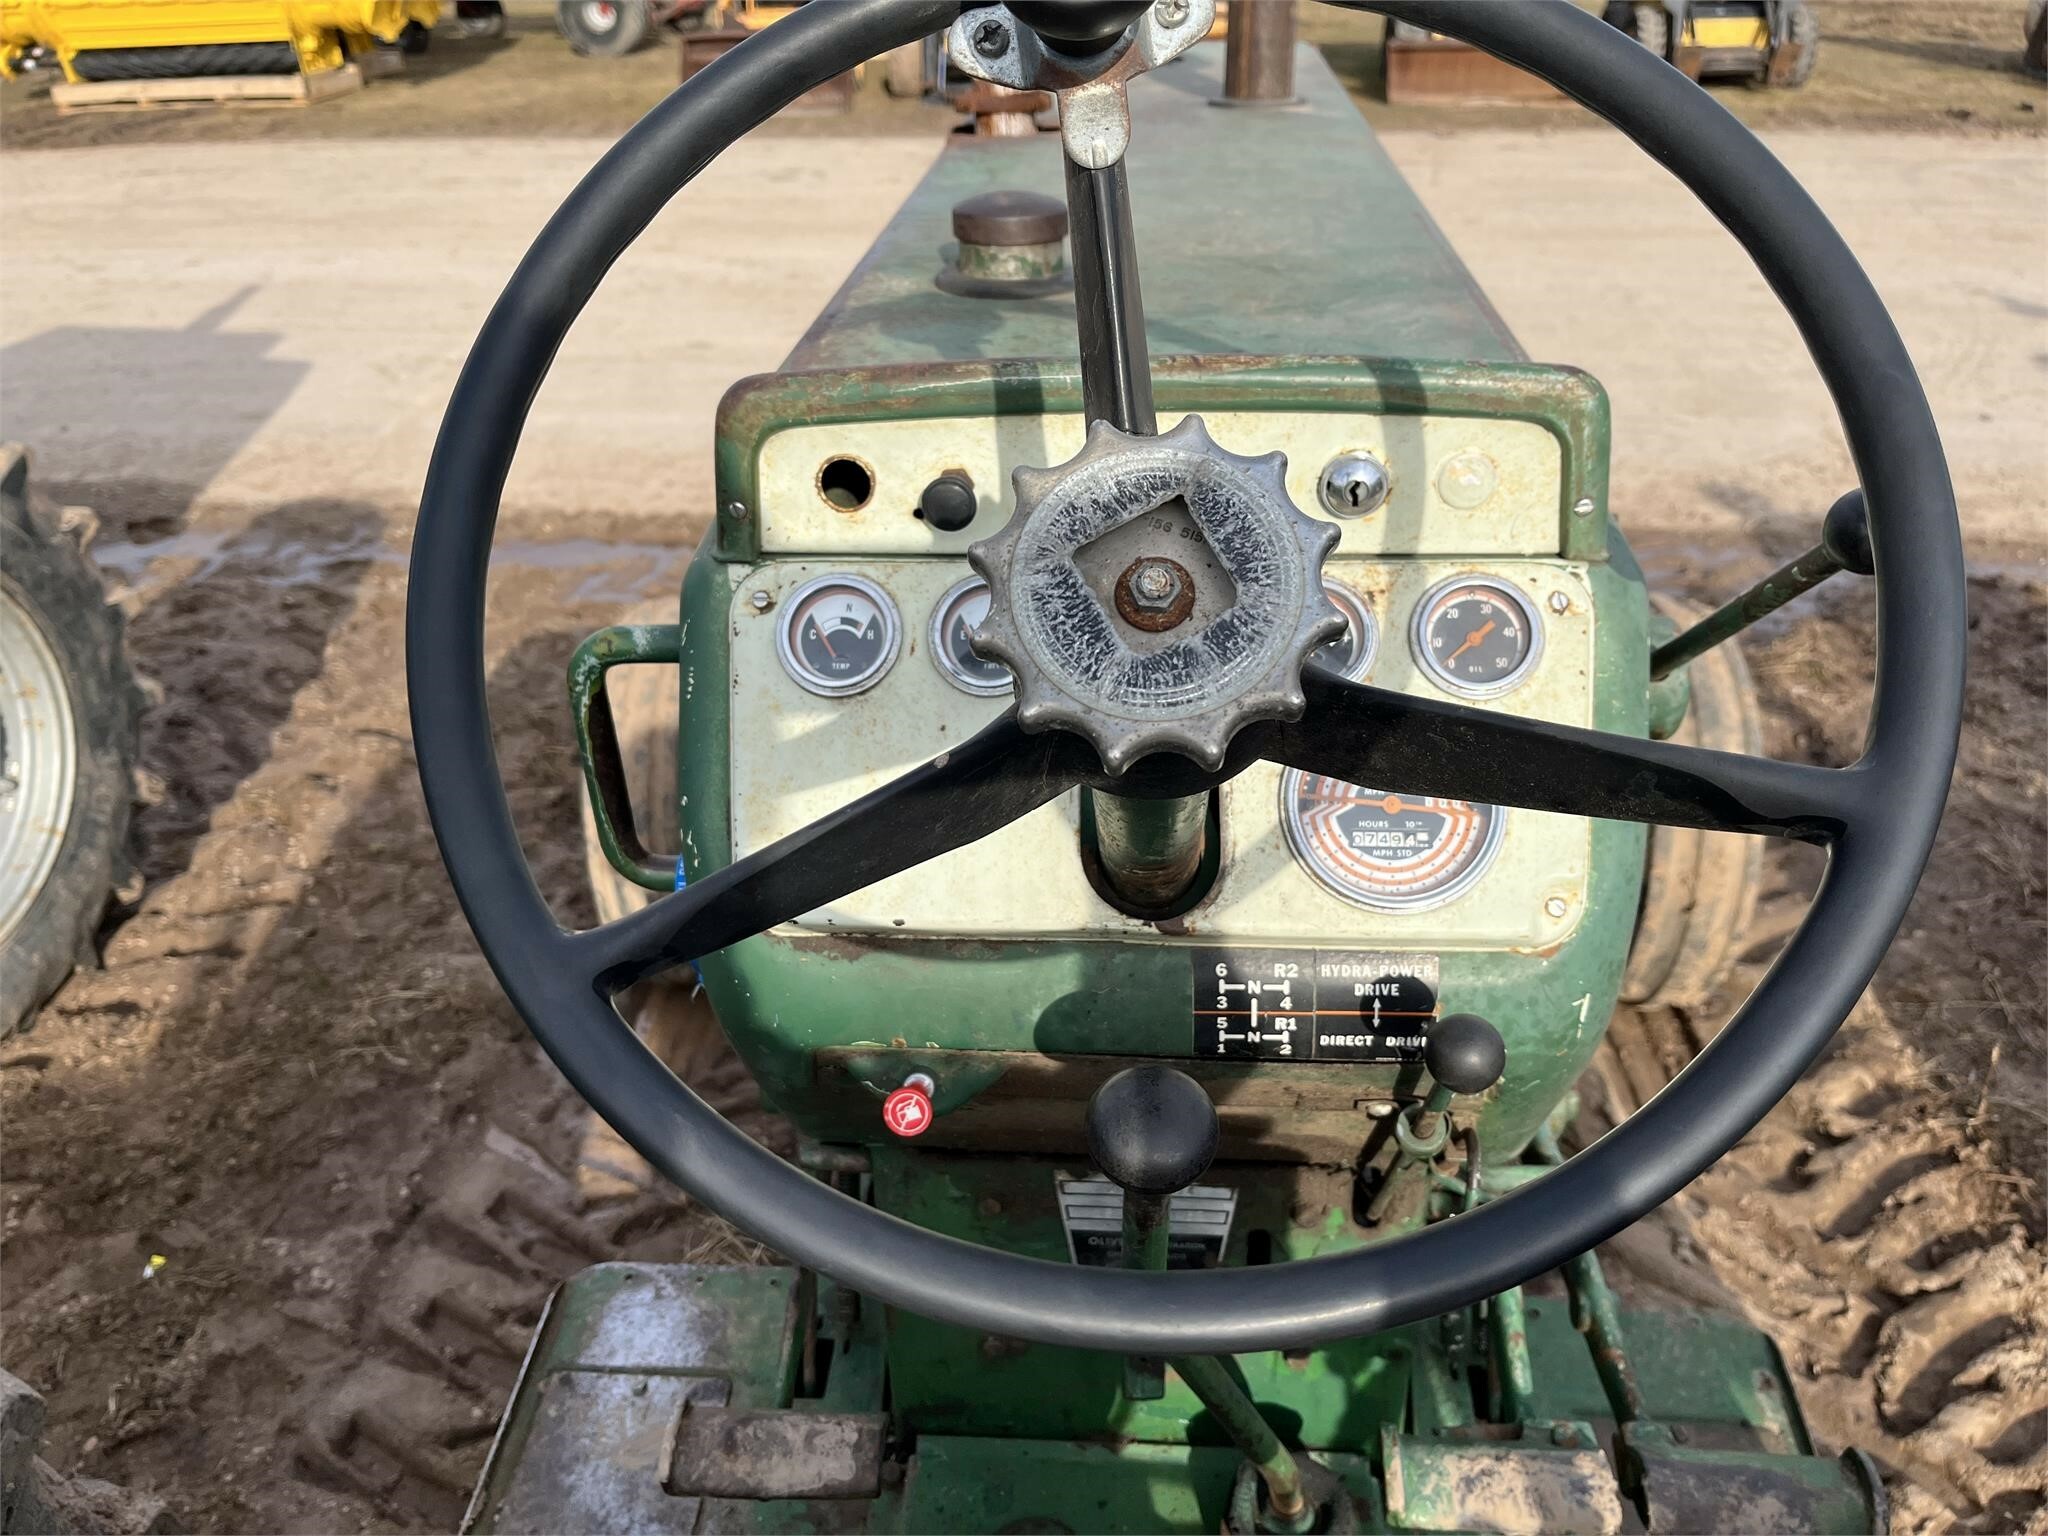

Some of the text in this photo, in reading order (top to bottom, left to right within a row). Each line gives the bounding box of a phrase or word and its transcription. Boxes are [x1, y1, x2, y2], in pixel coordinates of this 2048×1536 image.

[1446, 608, 1459, 619] 20
[1480, 604, 1492, 614] 30
[1503, 627, 1515, 637] 40
[1432, 637, 1442, 648] 10
[1448, 658, 1455, 669] 0
[1496, 657, 1508, 668] 50
[1358, 820, 1389, 828] HOURS
[1372, 849, 1413, 857] MPH STD
[1215, 963, 1298, 978] 6 R2
[1321, 964, 1433, 978] HYDRA-POWER
[1247, 980, 1262, 994] N
[1354, 983, 1400, 996] DRIVE
[1216, 996, 1292, 1010] 3 4
[1216, 1017, 1298, 1031] 5 R1
[1247, 1031, 1261, 1042] N
[1319, 1035, 1374, 1046] DIRECT
[1217, 1044, 1292, 1055] 1 2
